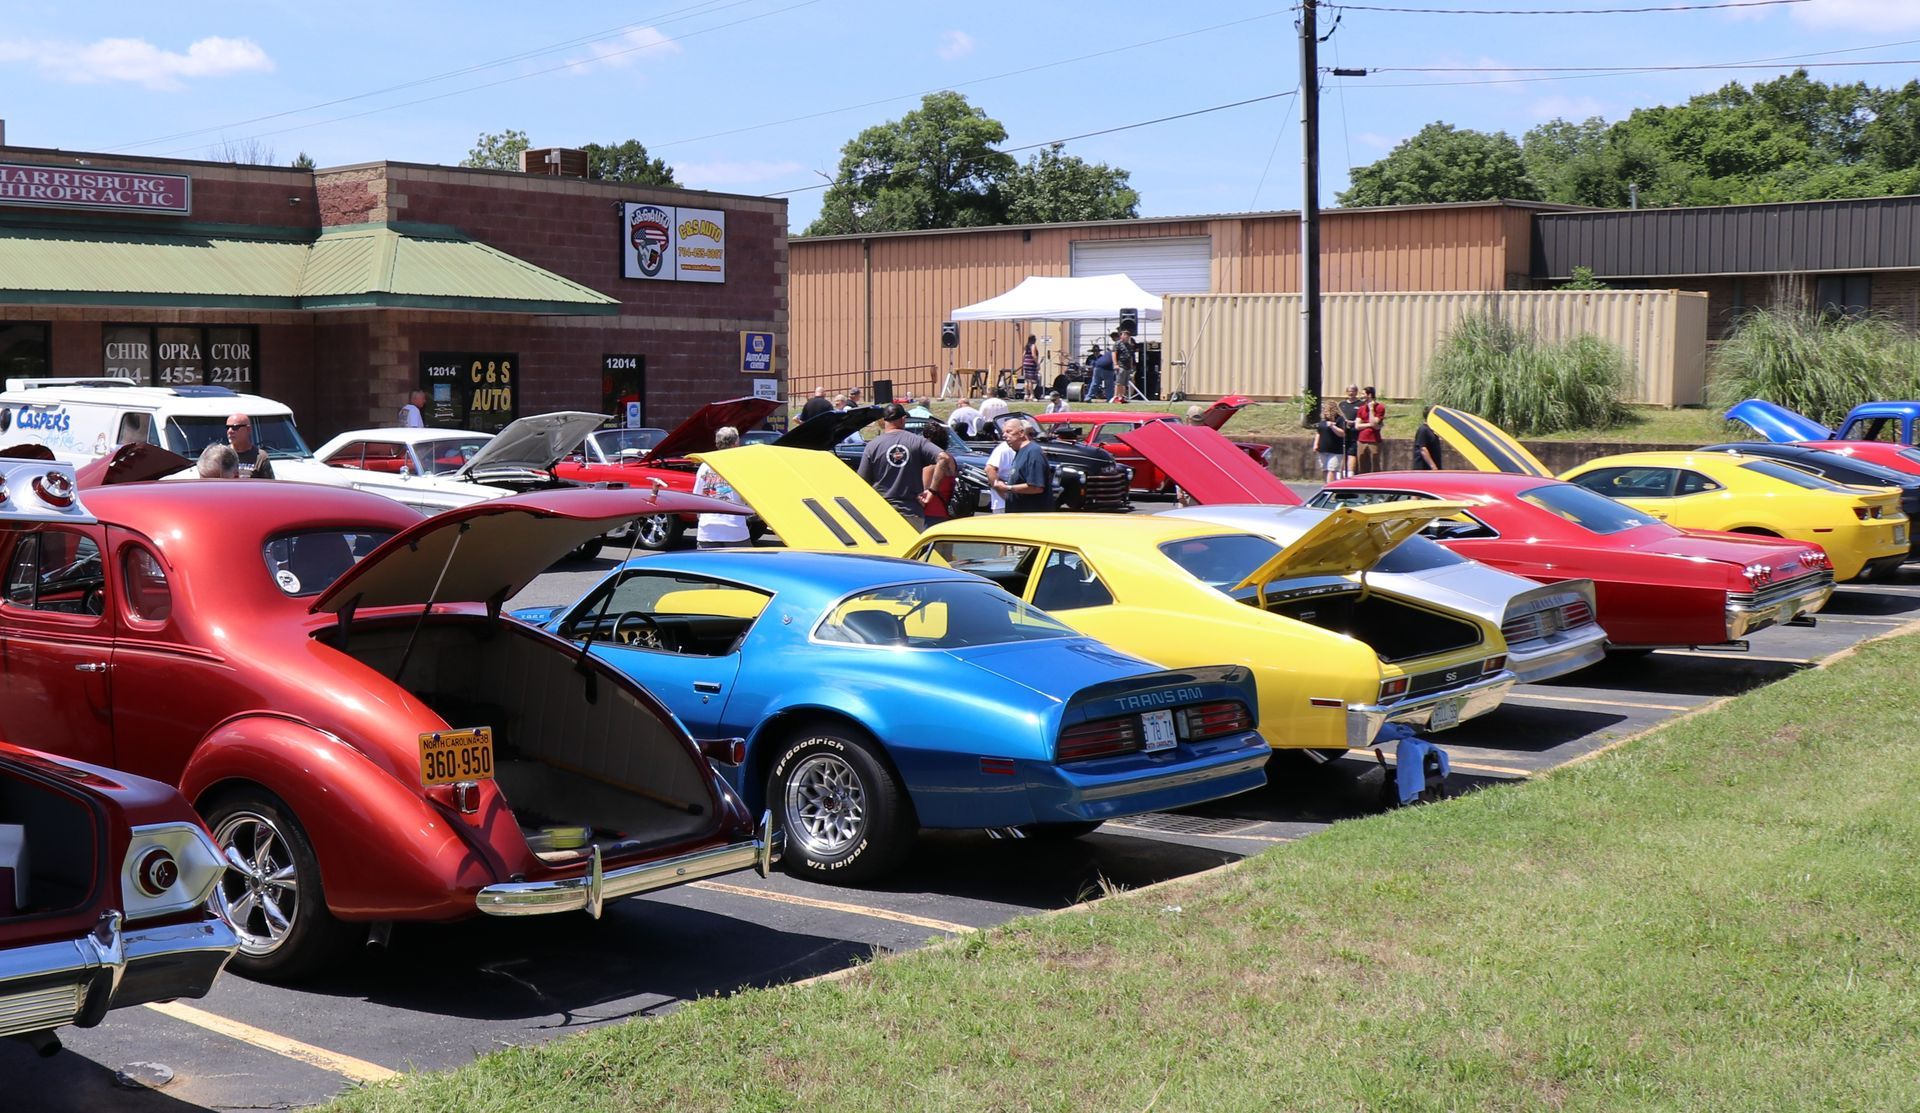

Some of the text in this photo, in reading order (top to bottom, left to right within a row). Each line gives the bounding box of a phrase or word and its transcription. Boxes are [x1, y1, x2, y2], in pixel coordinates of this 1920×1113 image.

[0, 183, 173, 206] HIROPRACTIC
[700, 219, 723, 243] AUTO
[105, 342, 251, 360] CHIR OPRA CTOR
[160, 366, 203, 383] 455-
[212, 367, 251, 383] 2211
[428, 366, 456, 376] 12014
[471, 361, 482, 383] C
[500, 361, 511, 383] S
[606, 358, 636, 369] 12014
[471, 388, 511, 411] AUTO
[1445, 672, 1457, 682] SS
[1115, 687, 1204, 711] TRANS AM
[423, 739, 445, 750] NORTH
[776, 737, 845, 777] BFGoodrich
[806, 838, 868, 871] Radial T/A
